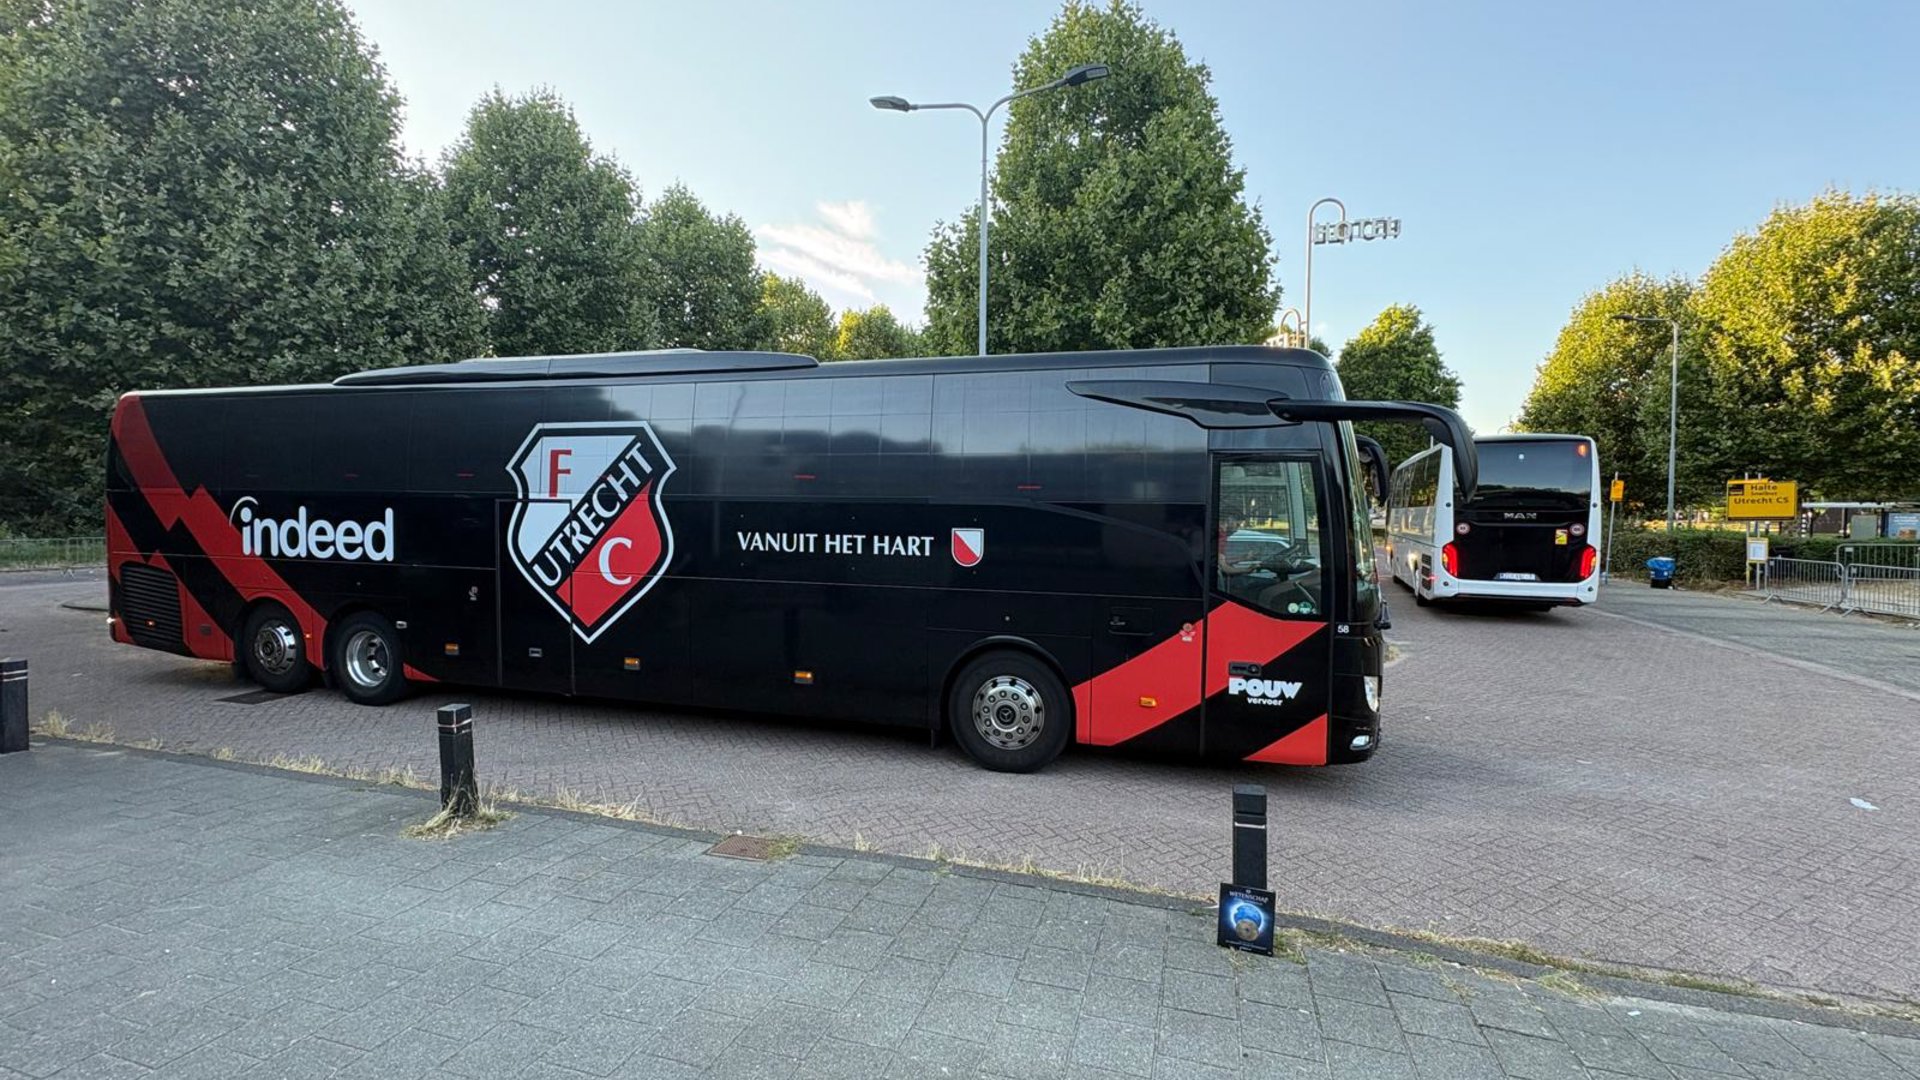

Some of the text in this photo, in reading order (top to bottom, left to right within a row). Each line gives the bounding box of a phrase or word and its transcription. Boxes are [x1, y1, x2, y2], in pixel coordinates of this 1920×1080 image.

[548, 449, 572, 498] F
[1750, 483, 1778, 491] Halte
[1777, 496, 1789, 504] CS
[532, 441, 654, 588] UTRECHT
[240, 505, 394, 562] indeed
[737, 531, 934, 557] VANUIT HET HART
[598, 537, 632, 586] C
[1337, 625, 1349, 633] 58
[1228, 677, 1302, 699] POUW
[1246, 697, 1283, 706] vervoer
